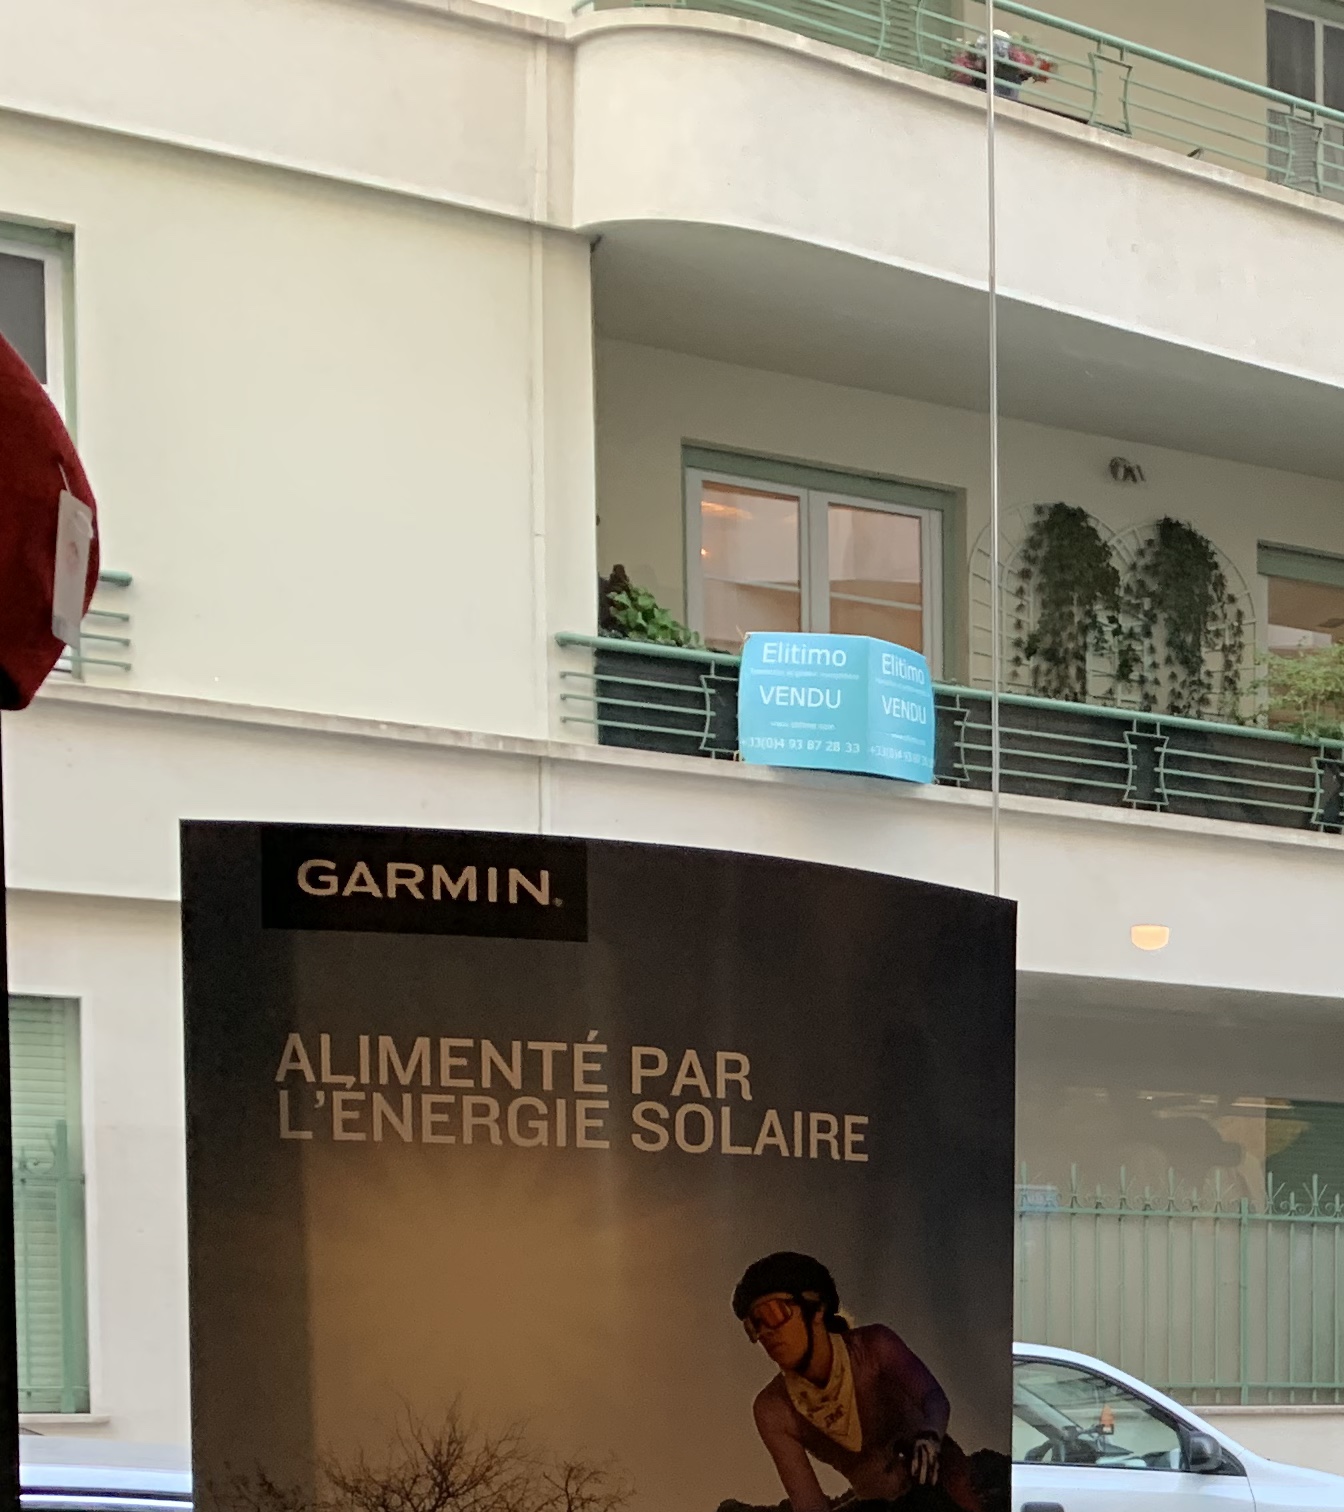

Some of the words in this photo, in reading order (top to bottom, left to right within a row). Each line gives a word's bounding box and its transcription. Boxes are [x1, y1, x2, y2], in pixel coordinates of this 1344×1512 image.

[762, 642, 847, 667] Elitimo
[881, 653, 925, 685] Elitimo
[759, 685, 842, 709] VENDU
[881, 695, 927, 724] VENDU
[845, 743, 860, 753] 33
[296, 858, 553, 907] GARMIN
[275, 1030, 609, 1094] ALIMENTÉ
[630, 1045, 753, 1101] PAR
[631, 1102, 870, 1163] SOLAIRE
